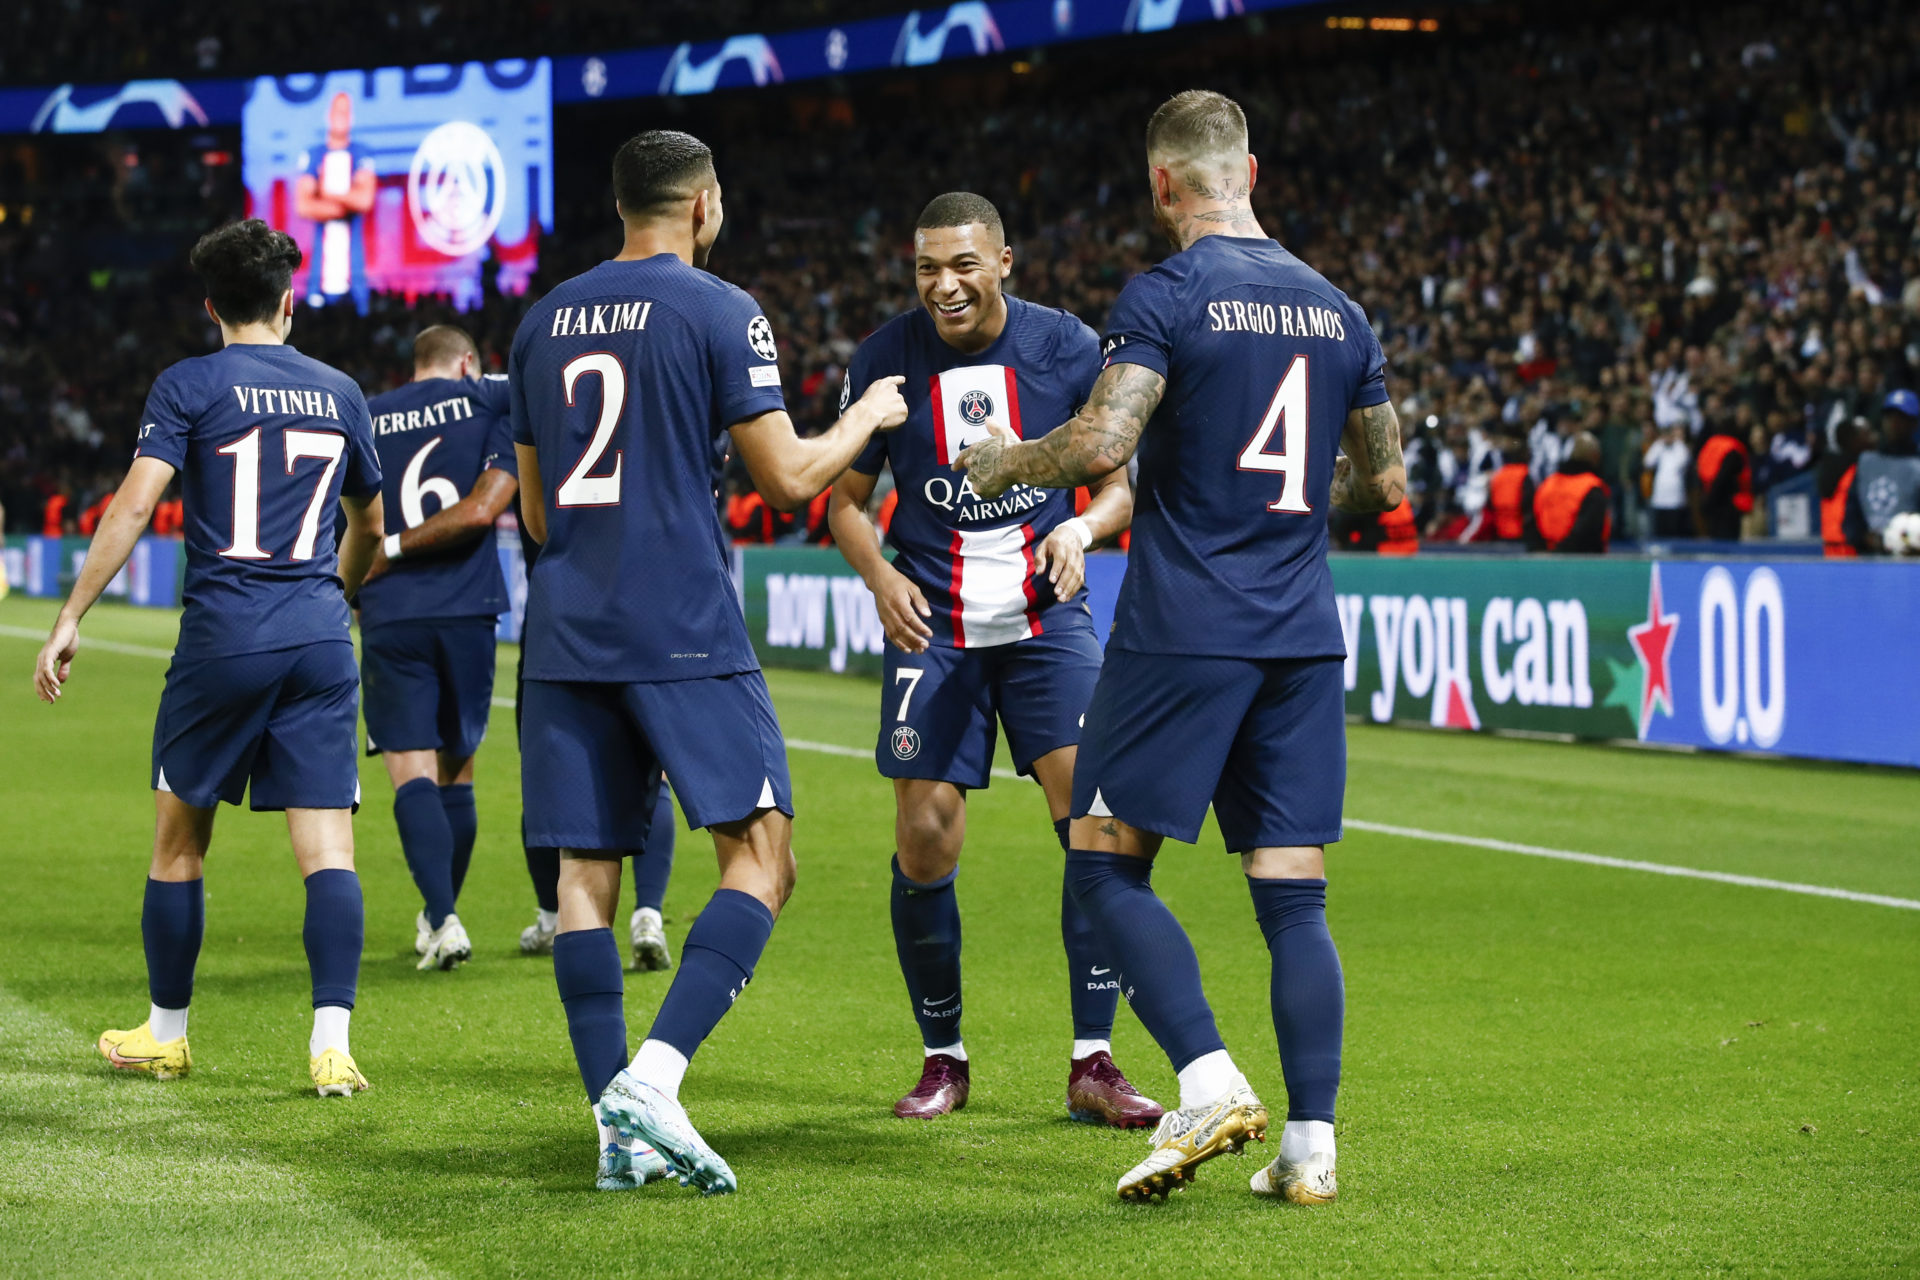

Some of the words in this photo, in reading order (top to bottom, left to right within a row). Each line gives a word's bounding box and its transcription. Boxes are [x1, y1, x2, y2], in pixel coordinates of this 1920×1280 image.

[551, 301, 653, 338] HAKIMI
[1207, 300, 1277, 335] SERGIO
[1279, 305, 1346, 342] RAMOS
[233, 385, 340, 421] VITINHA
[555, 350, 629, 509] 2
[1235, 353, 1315, 515] 4
[215, 425, 347, 562] 17
[400, 434, 461, 530] 6
[957, 486, 1047, 522] AIRWAYS
[895, 667, 925, 722] 7
[1369, 593, 1482, 730] you
[1480, 596, 1594, 708] can
[1700, 565, 1786, 749] 0.0
[895, 728, 915, 737] PARIS
